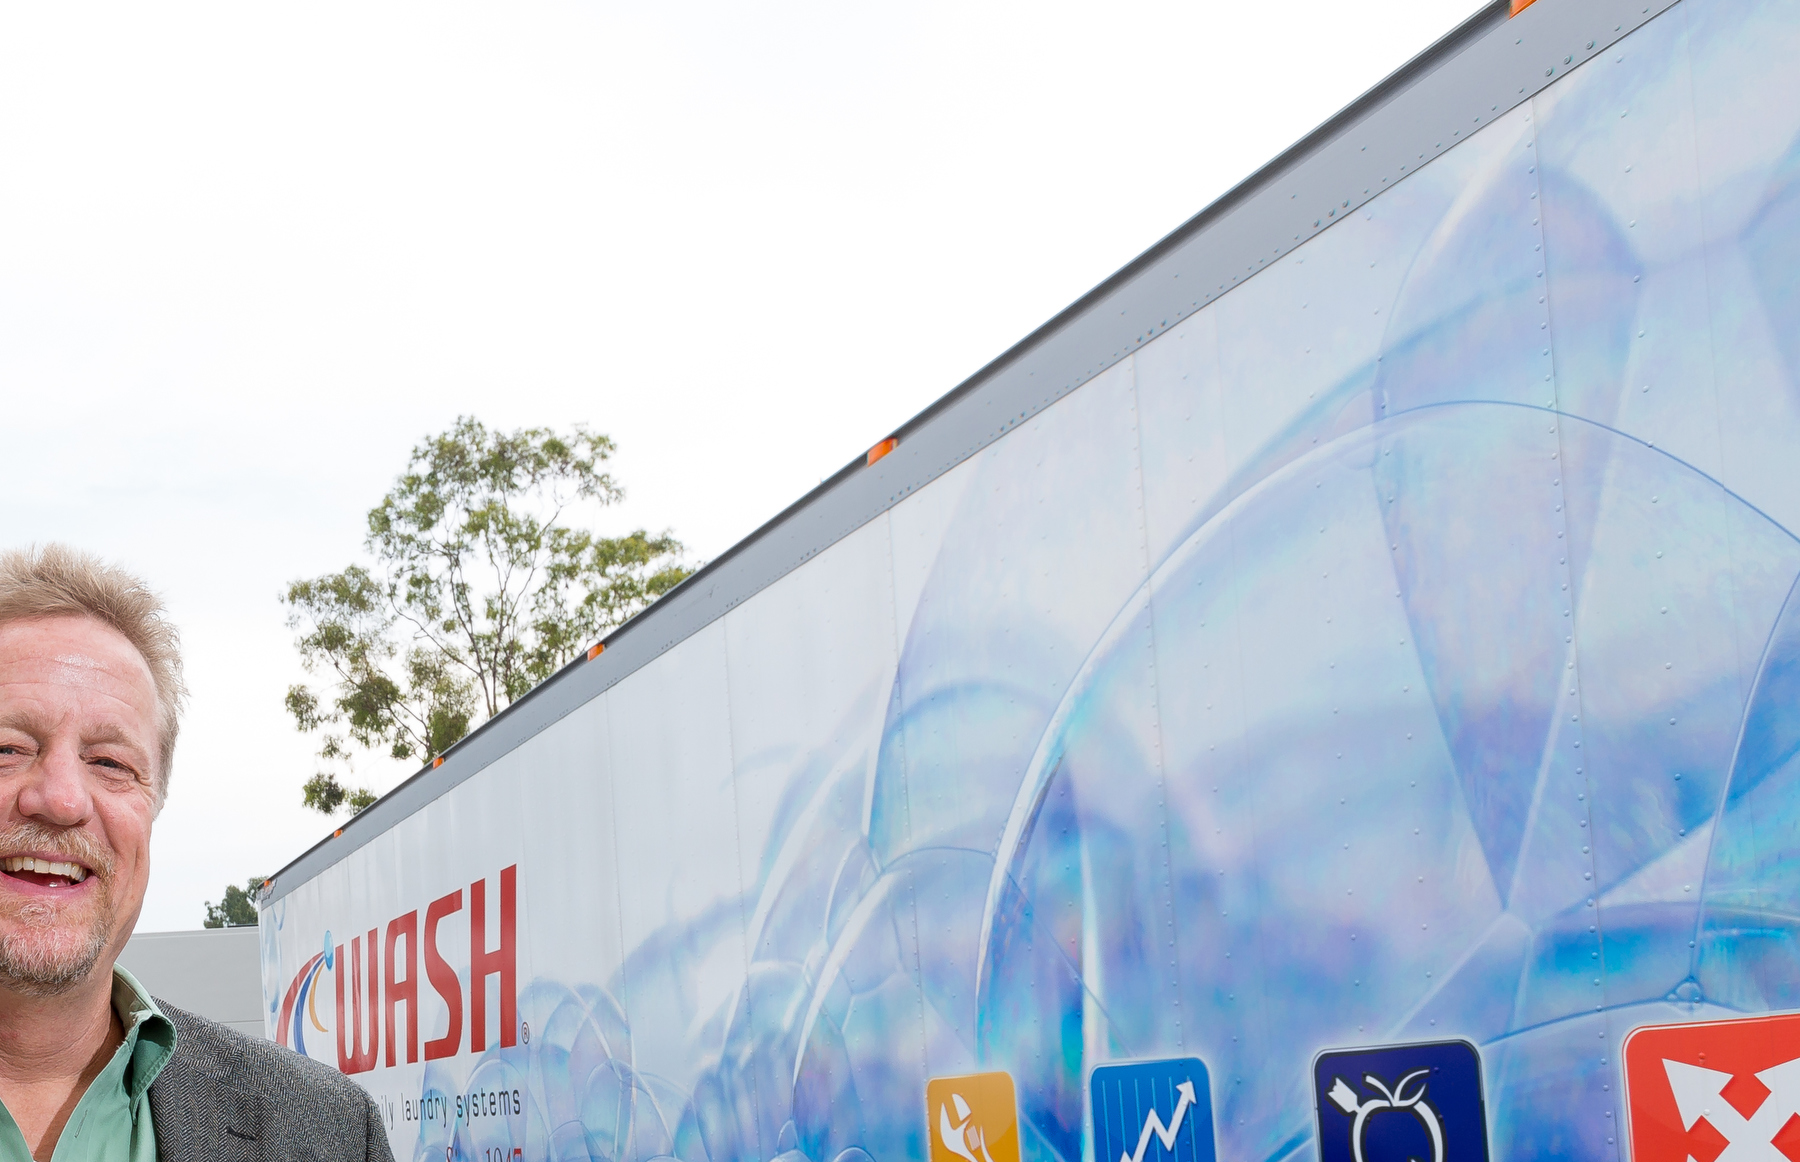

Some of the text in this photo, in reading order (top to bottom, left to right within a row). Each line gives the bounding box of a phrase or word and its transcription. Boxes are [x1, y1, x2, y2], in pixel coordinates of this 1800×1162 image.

[335, 863, 517, 1075] WASH
[400, 1089, 447, 1129] laundry
[456, 1087, 521, 1128] systems
